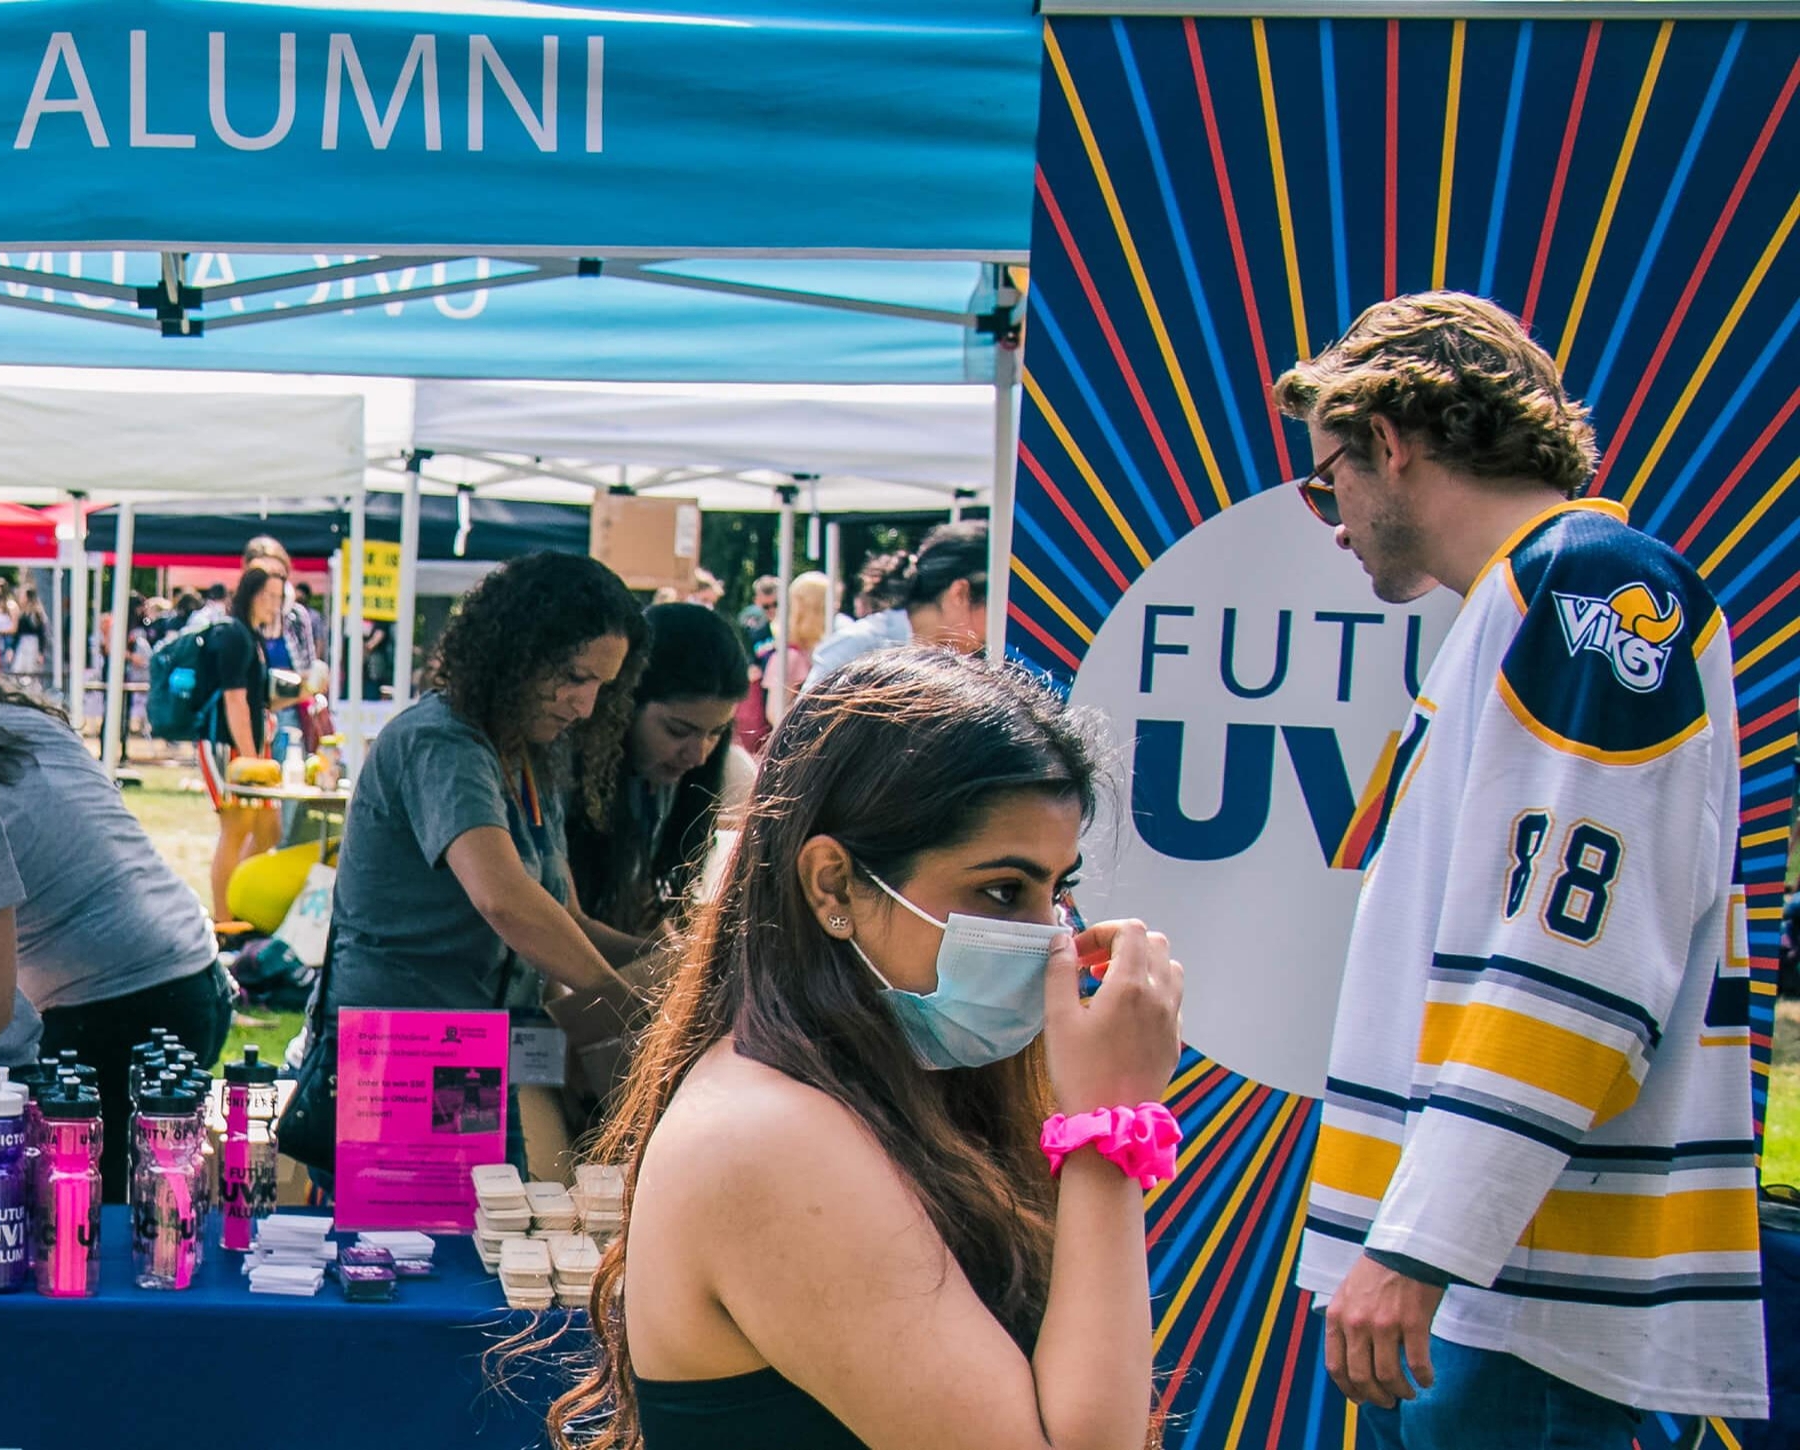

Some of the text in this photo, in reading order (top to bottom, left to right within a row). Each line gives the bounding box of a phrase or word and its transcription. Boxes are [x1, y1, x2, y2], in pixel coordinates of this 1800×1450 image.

[13, 30, 604, 154] ALUMNI
[1553, 590, 1672, 692] Vikes
[1503, 807, 1626, 948] 88
